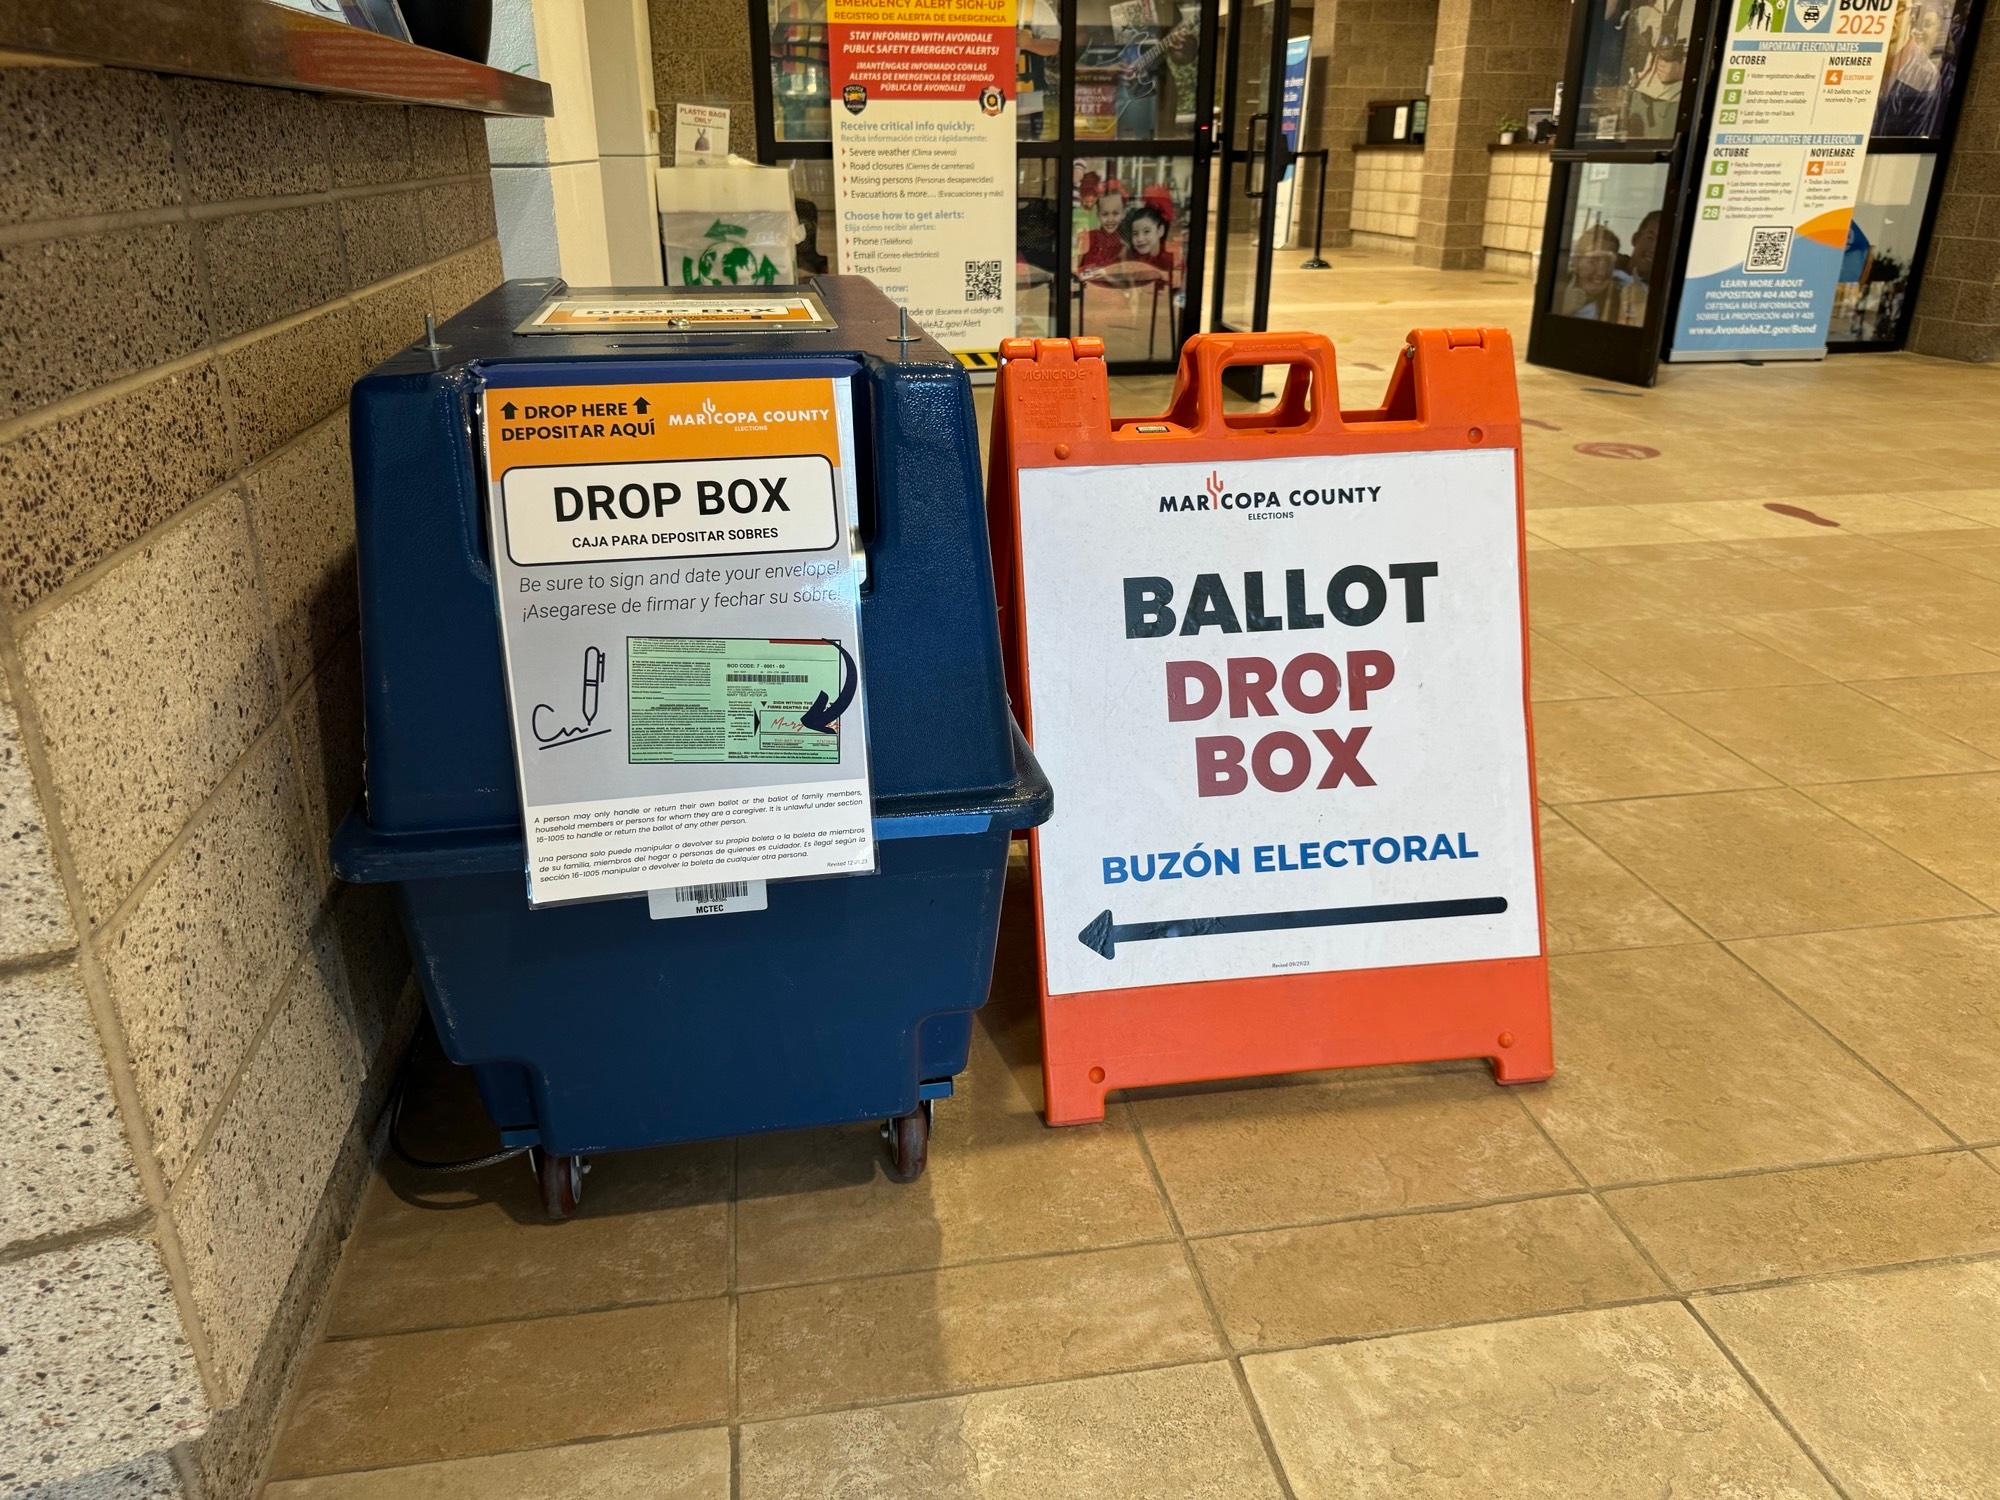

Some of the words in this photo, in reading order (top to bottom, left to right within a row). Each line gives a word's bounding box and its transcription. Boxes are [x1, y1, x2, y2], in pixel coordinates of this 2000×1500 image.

[835, 0, 910, 8] EMERGENCY
[914, 0, 951, 9] ALERT
[956, 0, 1005, 10] SIGN-UP
[1840, 0, 1893, 11] BOND
[934, 14, 946, 22] DE
[948, 15, 1006, 23] EMERGENCIA
[1837, 14, 1887, 34] 2025
[850, 31, 872, 41] STAY
[873, 32, 920, 42] INFORMED
[921, 33, 945, 42] WITH
[945, 33, 992, 42] AVONDALE
[843, 45, 874, 54] PUBLIC
[876, 45, 910, 54] SAFETY
[911, 45, 965, 55] EMERGENCY
[965, 46, 999, 56] ALERTS!
[1759, 42, 1800, 51] IMPORTANT
[1802, 42, 1836, 51] ELECTION
[1837, 42, 1860, 52] DATES
[1730, 55, 1766, 65] OCTOBER
[1829, 56, 1872, 67] NOVEMBER
[1732, 71, 1740, 82] 6
[1830, 73, 1838, 83] 4
[1728, 92, 1736, 102] 8
[680, 108, 707, 116] PLASTIC
[1721, 112, 1736, 122] 28
[841, 122, 878, 131] Receive
[880, 122, 913, 131] critical
[915, 122, 934, 131] info
[937, 122, 975, 133] quickly:
[849, 149, 876, 157] Severe
[877, 148, 910, 157] weather
[1713, 148, 1749, 157] OCTUBRE
[1810, 148, 1855, 157] NOVIEMBRE
[850, 162, 870, 170] Road
[872, 162, 904, 170] closures
[1715, 163, 1724, 173] 6
[1810, 164, 1820, 173] 4
[850, 176, 881, 186] Missing
[882, 177, 913, 185] persons
[851, 190, 898, 199] Evacuations
[899, 190, 906, 198] &
[1711, 186, 1719, 196] 8
[844, 211, 880, 221] Choose
[882, 211, 903, 220] how
[905, 212, 915, 220] to
[917, 212, 933, 221] get
[935, 211, 964, 220] alerts:
[1703, 208, 1718, 218] 28
[853, 237, 879, 245] Phone
[853, 251, 875, 259] Email
[854, 265, 875, 273] Texts
[1720, 280, 1748, 288] LEARN
[1749, 280, 1774, 288] MORE
[1705, 291, 1761, 299] PROPOSITION
[524, 404, 576, 418] DROP
[581, 401, 627, 417] HERE
[668, 398, 757, 426] MARICOPA
[763, 408, 830, 424] COUNTY
[501, 424, 604, 441] DEPOSITAR
[609, 417, 654, 437] AQUÍ
[1159, 470, 1280, 512] MARICOPA
[1288, 486, 1382, 507] COUNTY
[553, 482, 682, 522] DROP
[696, 476, 791, 516] BOX
[1248, 511, 1294, 521] ELECTIONS
[572, 536, 608, 547] CAJA
[611, 534, 648, 546] PARA
[651, 530, 724, 544] DEPOSITAR
[728, 527, 778, 540] SOBRES
[519, 577, 541, 592] Be
[546, 577, 583, 591] sure
[587, 574, 604, 588] to
[609, 572, 643, 590] sign
[649, 568, 680, 585] and
[684, 567, 720, 583] date
[724, 567, 760, 584] your
[765, 559, 839, 579] envelope!
[1122, 562, 1438, 639] BALLOT
[523, 602, 616, 622] ¡Asegarese
[621, 597, 641, 613] de
[646, 596, 696, 611] firmar
[700, 596, 709, 612] y
[714, 591, 765, 607] fechar
[769, 592, 788, 604] su
[1165, 650, 1395, 722] DROP
[1195, 726, 1378, 798] BOX
[542, 815, 569, 824] person
[593, 810, 610, 818] only
[801, 792, 823, 800] family
[535, 823, 575, 833] household
[577, 820, 613, 828] members
[625, 816, 655, 826] persons
[732, 807, 767, 815] caregiver.
[783, 802, 813, 810] unlawful
[536, 833, 564, 843] 16-1005
[576, 830, 602, 838] handle
[720, 818, 747, 827] person.
[1102, 842, 1240, 885] BUZÓN
[1254, 832, 1479, 874] ELECTORAL
[696, 904, 724, 914] MCTEC
